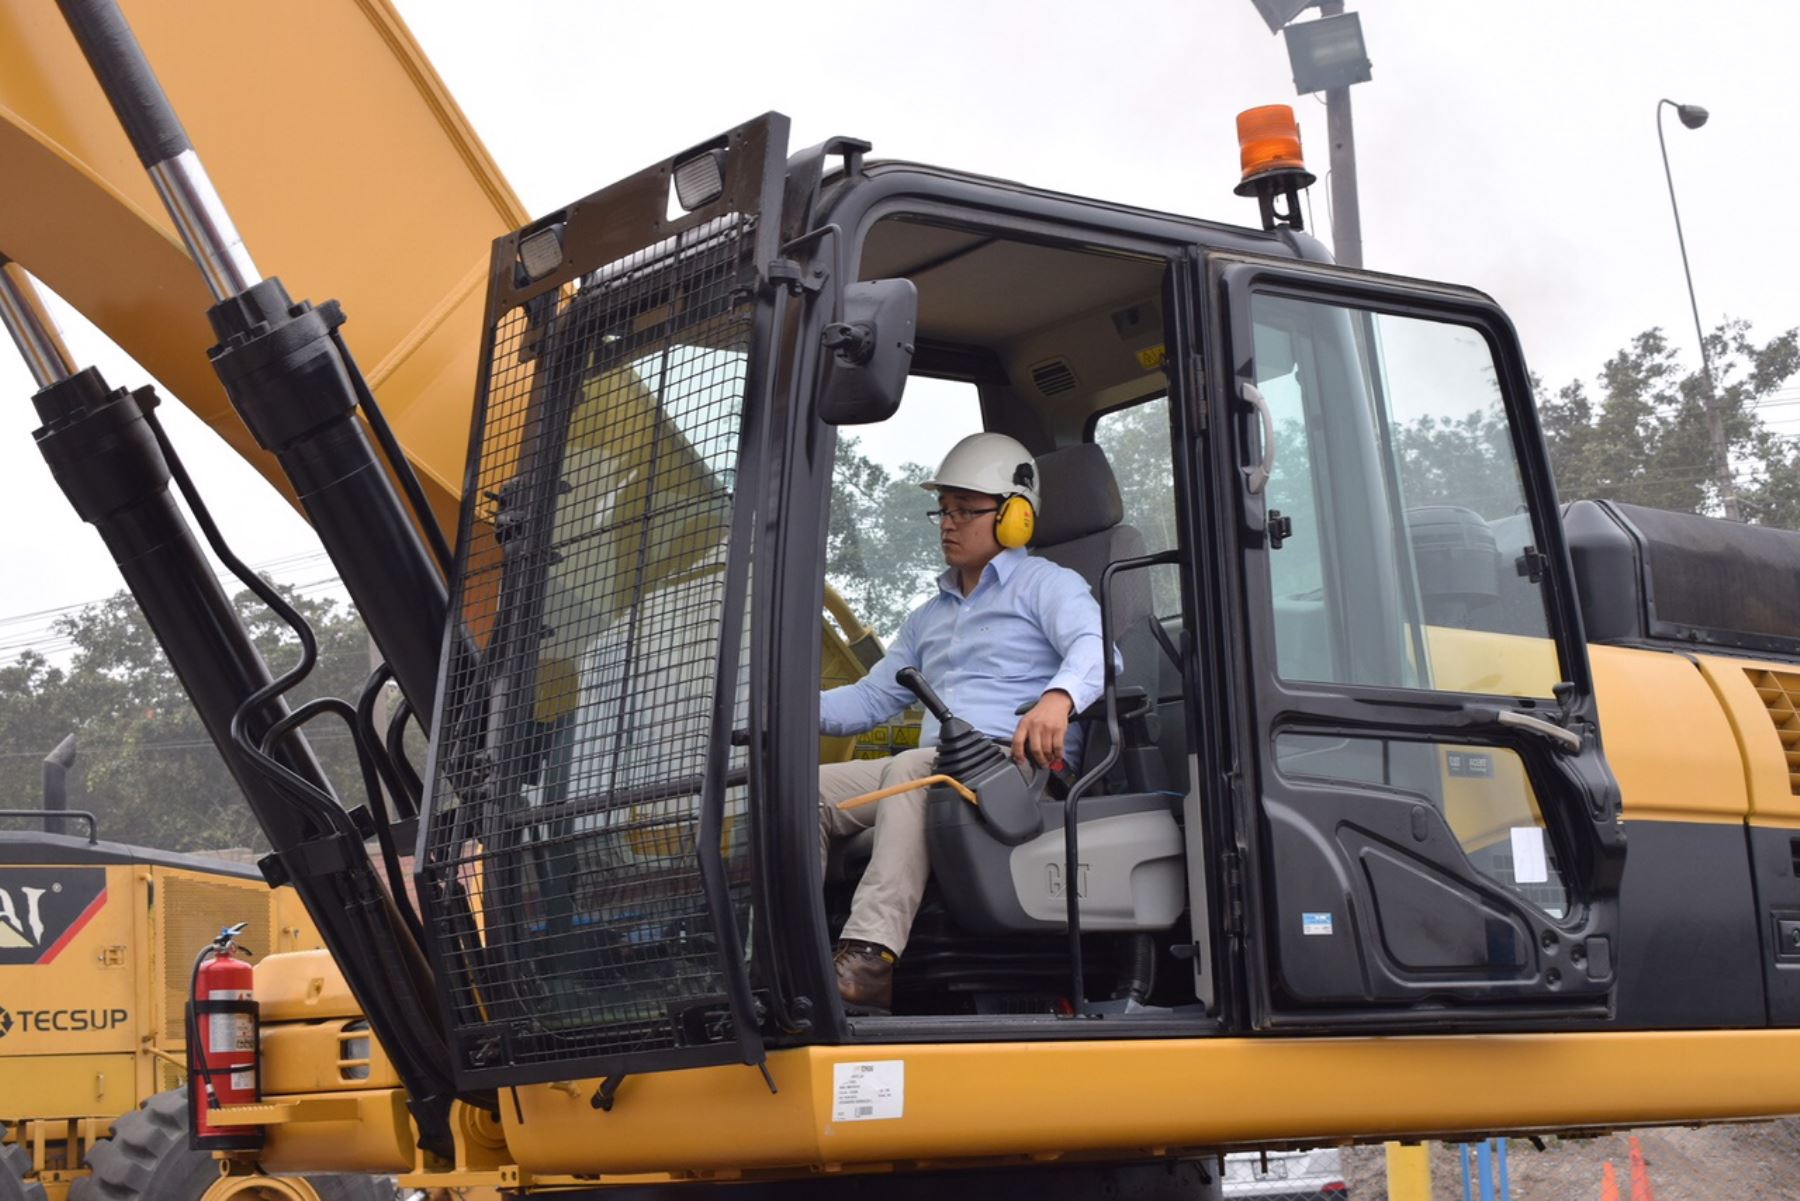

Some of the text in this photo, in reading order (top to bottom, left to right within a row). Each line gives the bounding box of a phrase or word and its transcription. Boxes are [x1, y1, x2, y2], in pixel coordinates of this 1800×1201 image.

[1044, 862, 1091, 900] CT
[0, 886, 47, 945] AT
[16, 1008, 128, 1033] TECSUP
